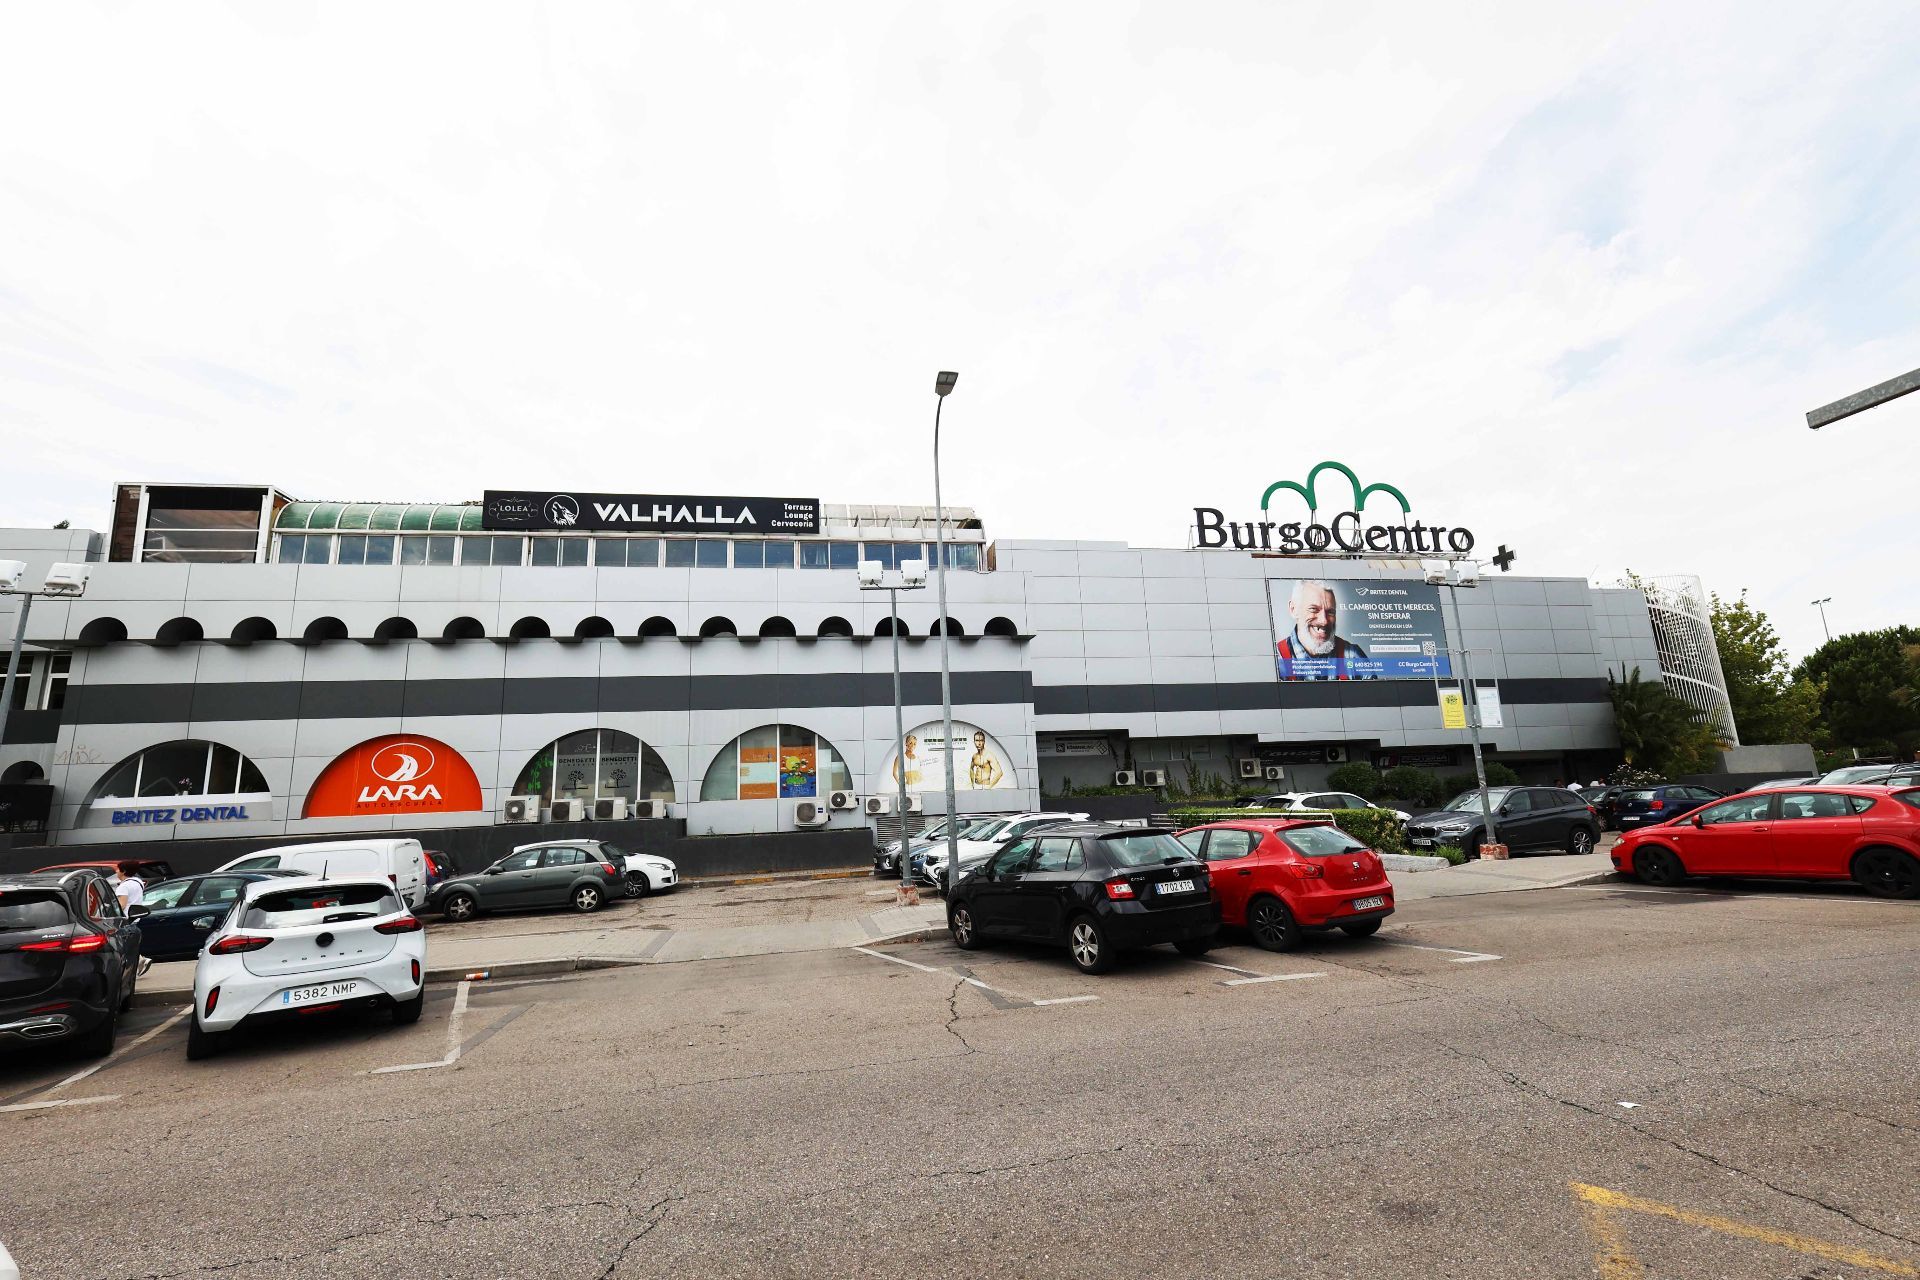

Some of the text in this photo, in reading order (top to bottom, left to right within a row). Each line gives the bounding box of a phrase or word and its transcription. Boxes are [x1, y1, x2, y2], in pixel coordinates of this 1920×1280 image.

[784, 503, 813, 511] Terraza
[593, 503, 757, 524] VALHALLA
[784, 511, 813, 520] Lounge
[1340, 603, 1347, 611] EL
[1348, 603, 1377, 611] CAMBIO
[1403, 603, 1436, 612] MERECES,
[357, 784, 443, 802] LARA
[356, 800, 442, 809] AUTOESCUELA
[112, 805, 248, 825] BRITEZ DENTAL
[1161, 882, 1179, 893] 1702
[294, 982, 357, 1001] 5382 NMP
